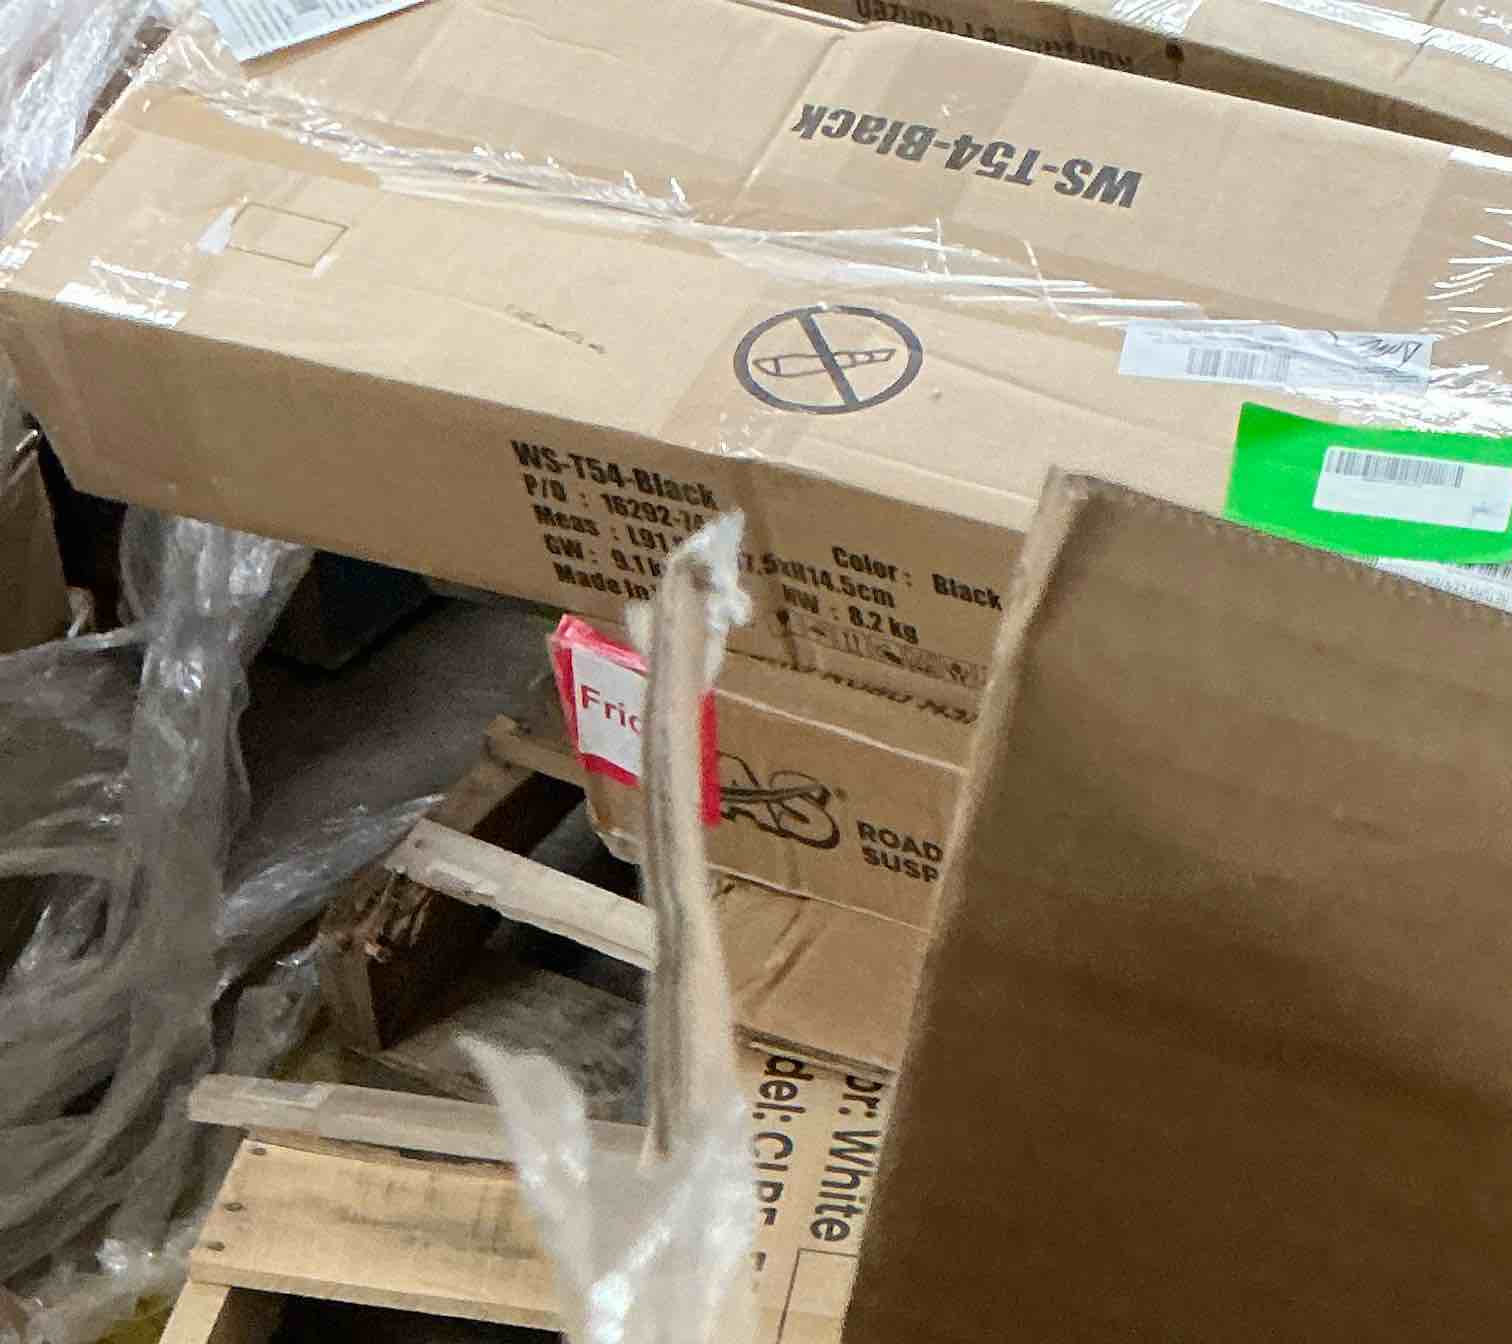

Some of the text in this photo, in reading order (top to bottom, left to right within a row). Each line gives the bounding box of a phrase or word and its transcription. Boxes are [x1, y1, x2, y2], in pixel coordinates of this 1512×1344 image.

[793, 103, 1143, 209] WS-T54-Black
[511, 440, 718, 511] WS-T54-Black
[856, 819, 944, 862] ROAD
[808, 1128, 882, 1244] White
